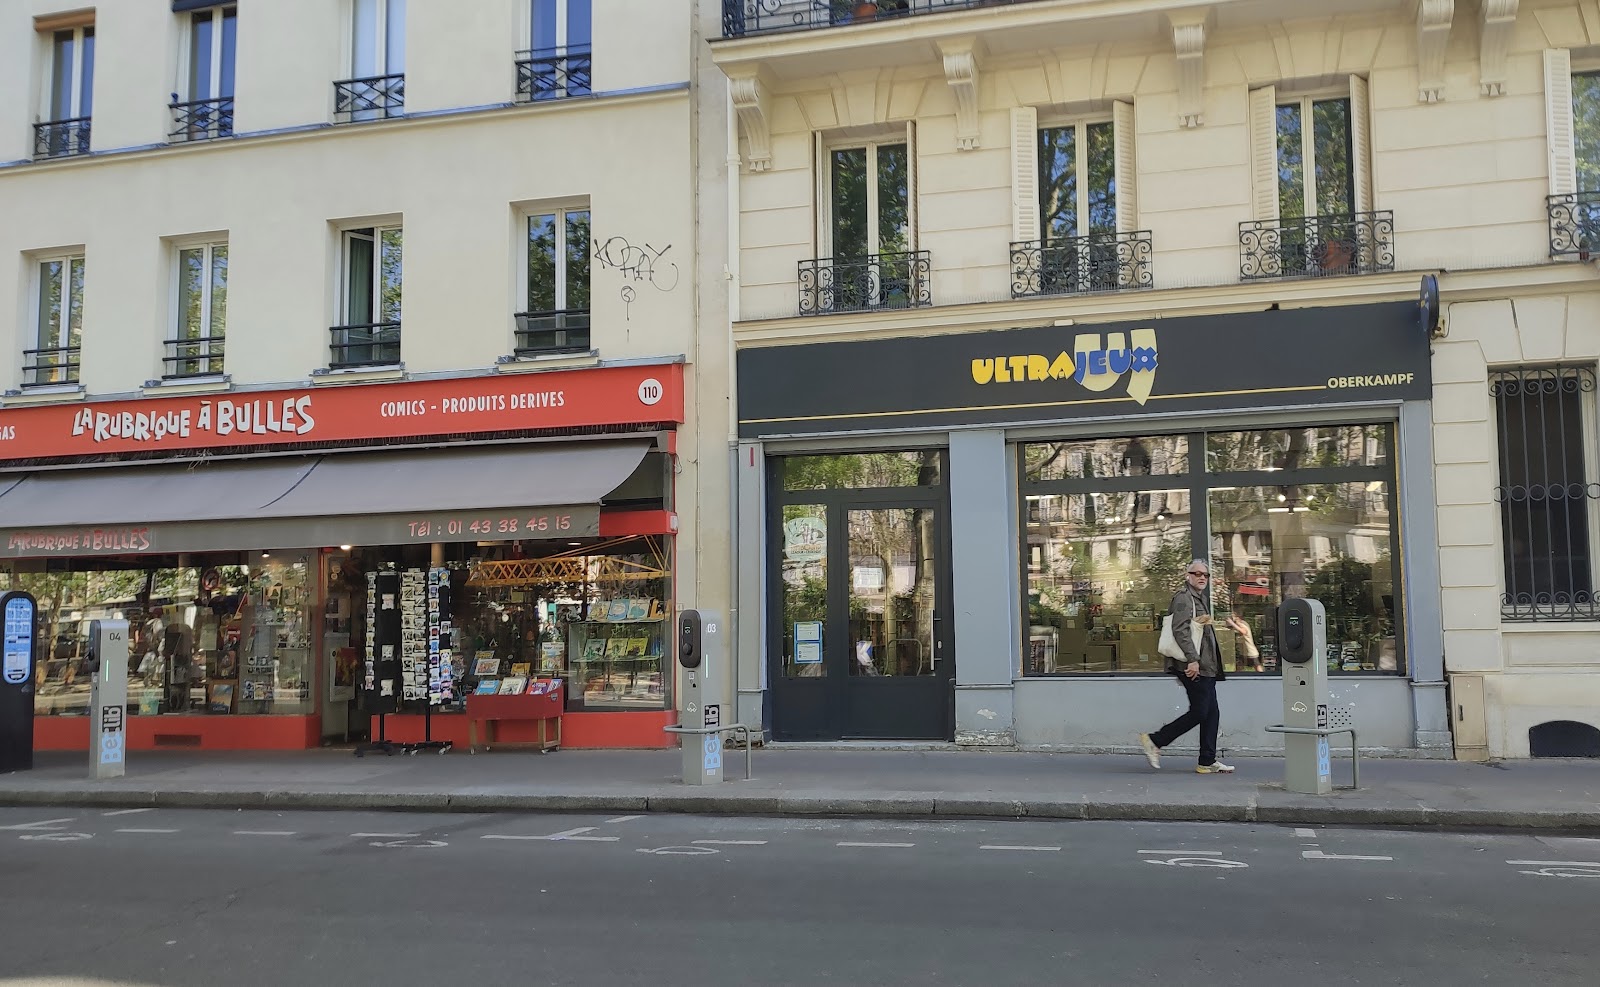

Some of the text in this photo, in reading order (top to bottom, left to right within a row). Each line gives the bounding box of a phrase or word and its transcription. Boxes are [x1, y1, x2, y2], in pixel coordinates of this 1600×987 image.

[1327, 372, 1414, 389] OBERKAMPF
[643, 385, 658, 399] 110
[380, 400, 426, 418] COMICS
[442, 395, 506, 414] PRODUITS
[510, 390, 565, 410] DERIVES
[72, 407, 93, 437] LA
[93, 409, 191, 443] RUBRIQUE
[216, 395, 315, 436] BULLES
[408, 521, 431, 537] Tél
[448, 520, 462, 535] 01
[469, 519, 491, 534] 43
[498, 518, 519, 533] 38
[526, 515, 548, 532] 45
[555, 515, 571, 530] 15
[20, 532, 79, 551] RUBRIQUE
[92, 527, 150, 551] BULLES
[109, 632, 121, 641] 04
[707, 623, 716, 633] 03
